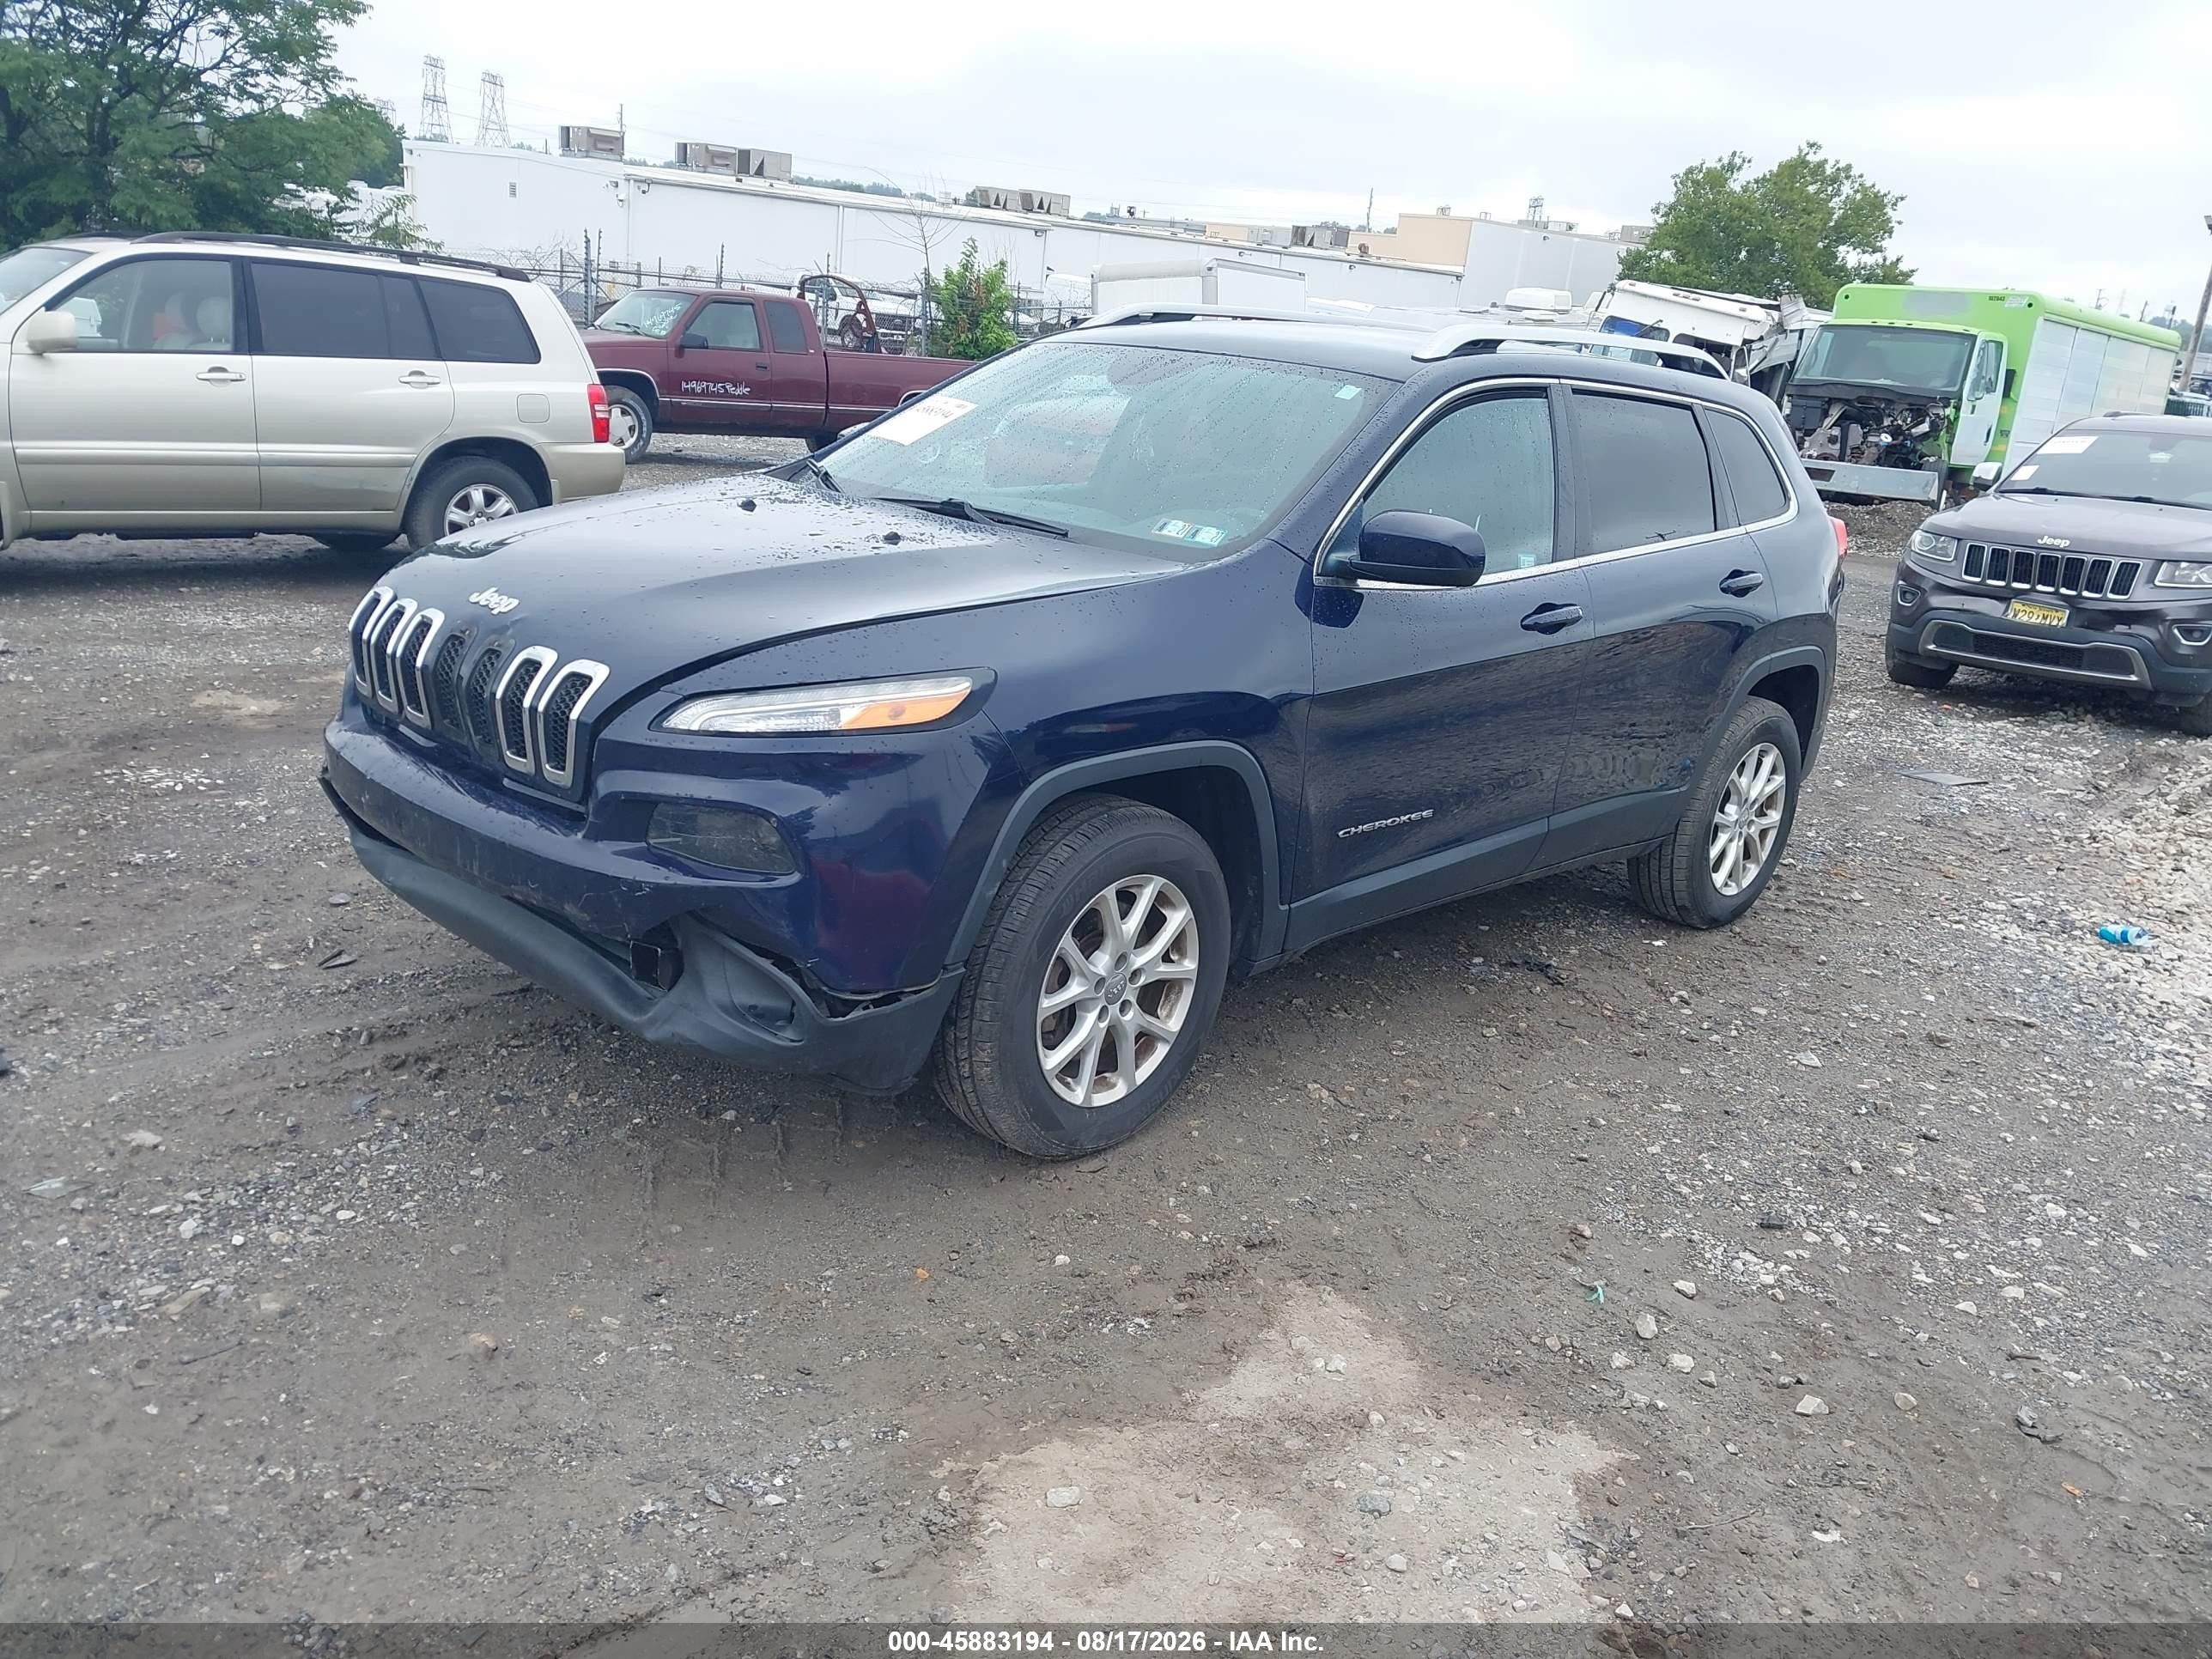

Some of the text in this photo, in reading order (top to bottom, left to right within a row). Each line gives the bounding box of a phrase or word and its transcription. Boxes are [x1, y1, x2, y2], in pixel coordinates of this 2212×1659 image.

[681, 380, 725, 395] 14969745
[2037, 535, 2071, 548] Jeep
[468, 586, 520, 615] Jeep
[1338, 809, 1434, 838] CHEROKEE
